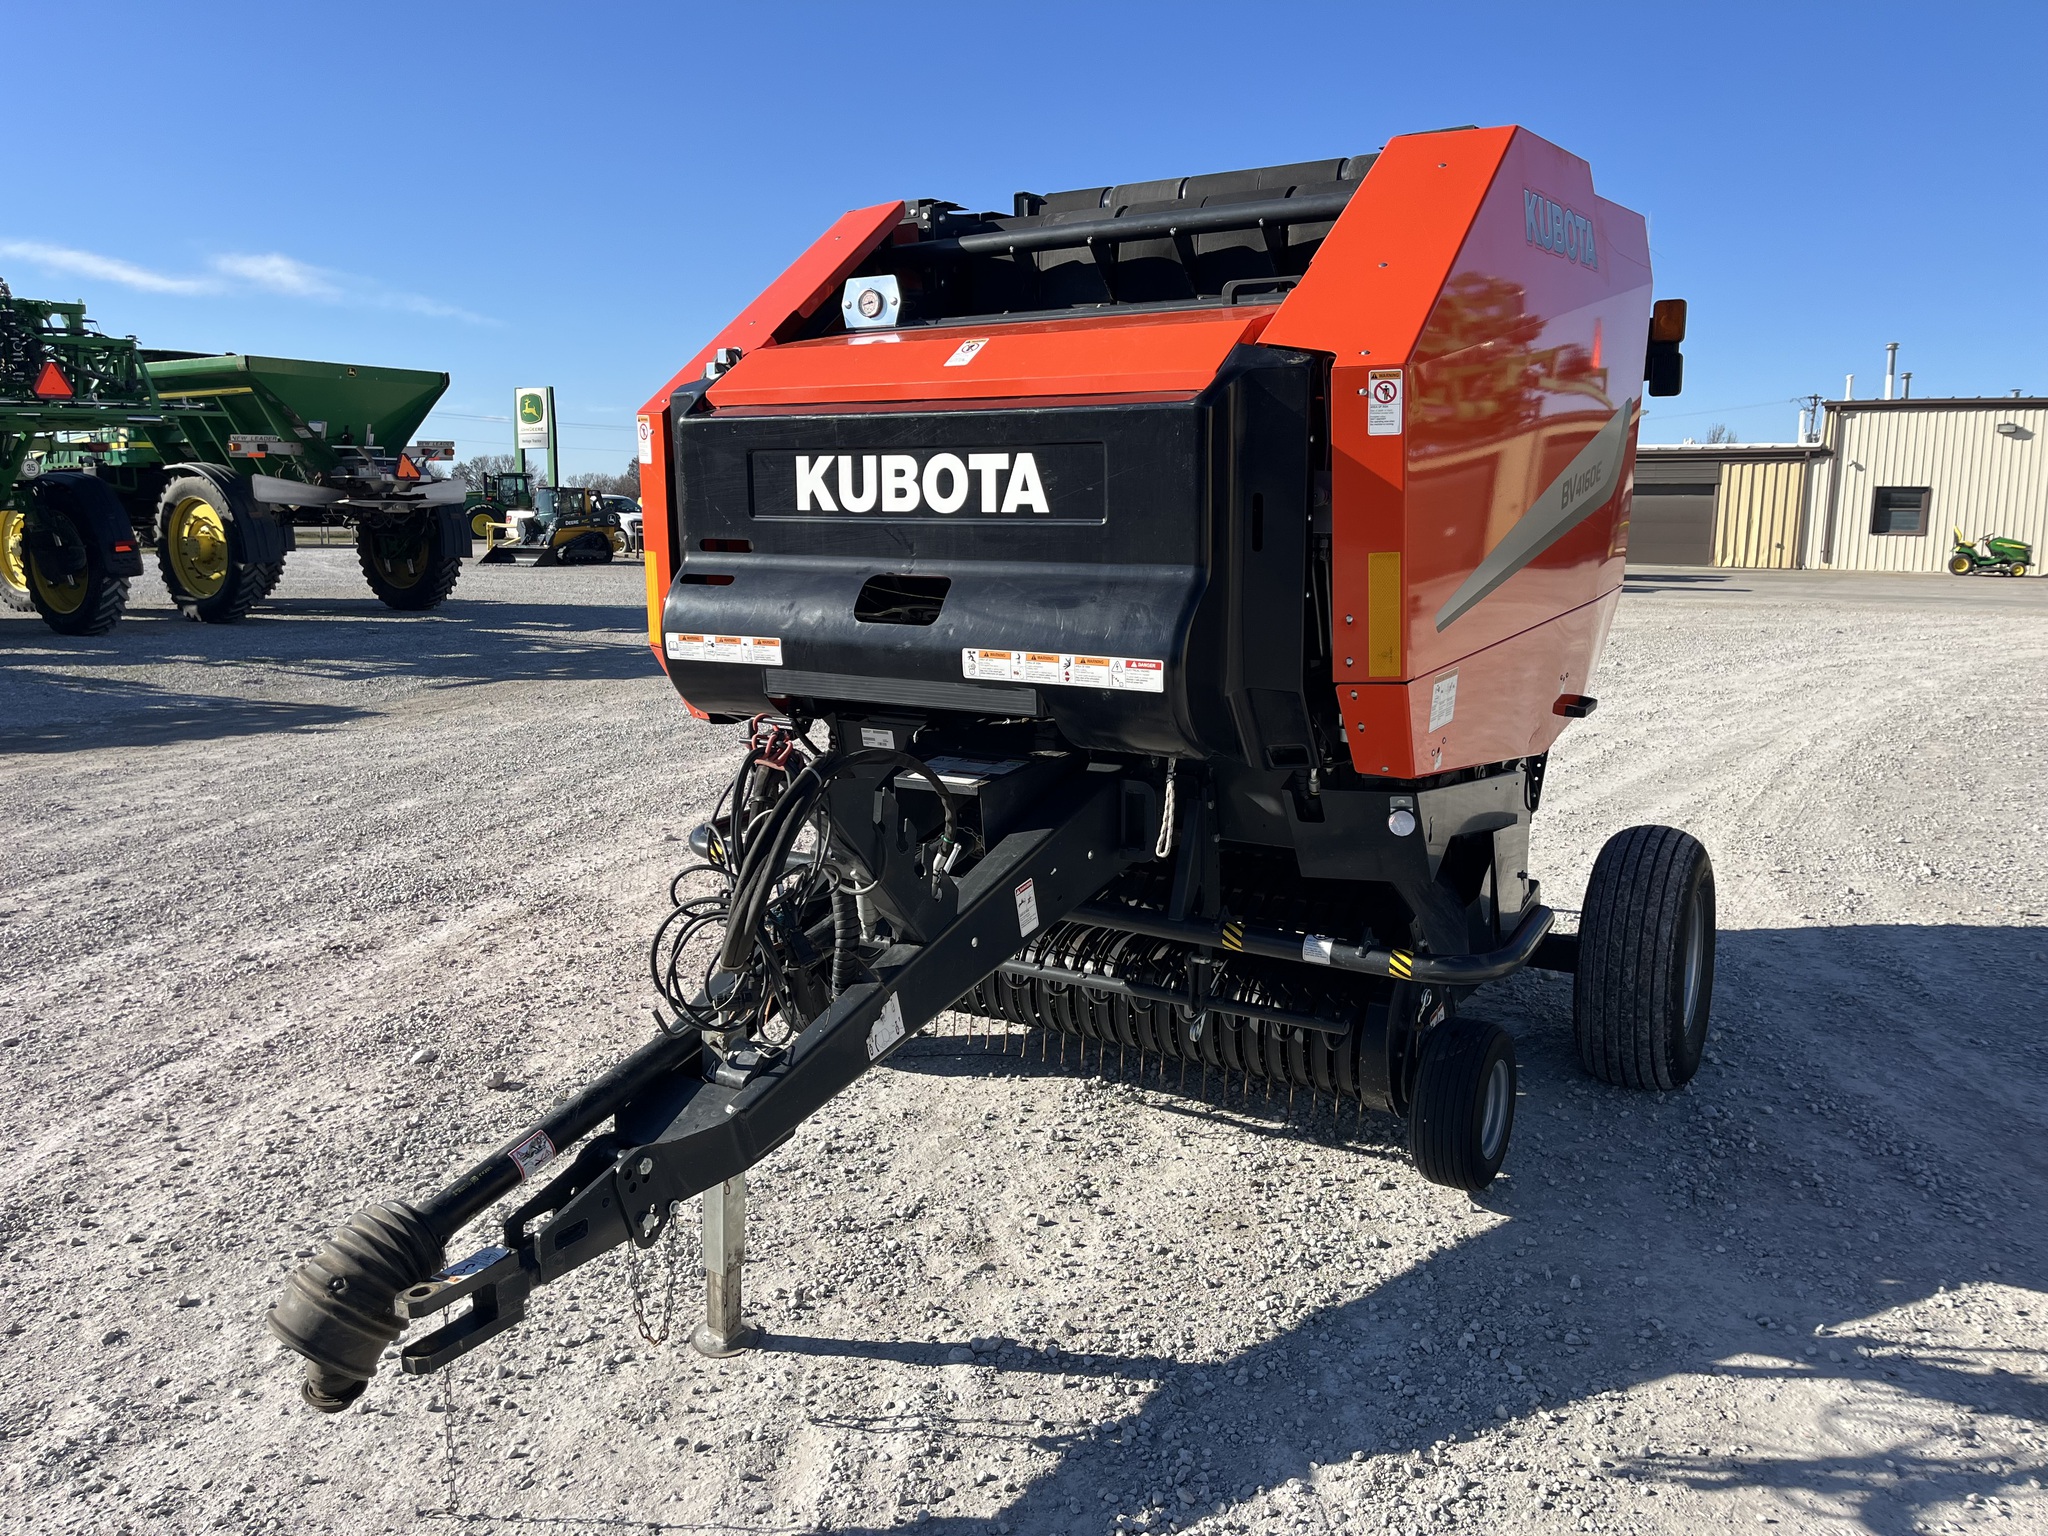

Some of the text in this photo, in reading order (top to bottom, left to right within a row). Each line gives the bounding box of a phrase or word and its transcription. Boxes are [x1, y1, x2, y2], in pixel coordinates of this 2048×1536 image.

[1524, 188, 1598, 269] KUBOTA
[27, 463, 36, 471] 35
[795, 452, 1050, 514] KUBOTA
[1561, 460, 1602, 510] BV4160E
